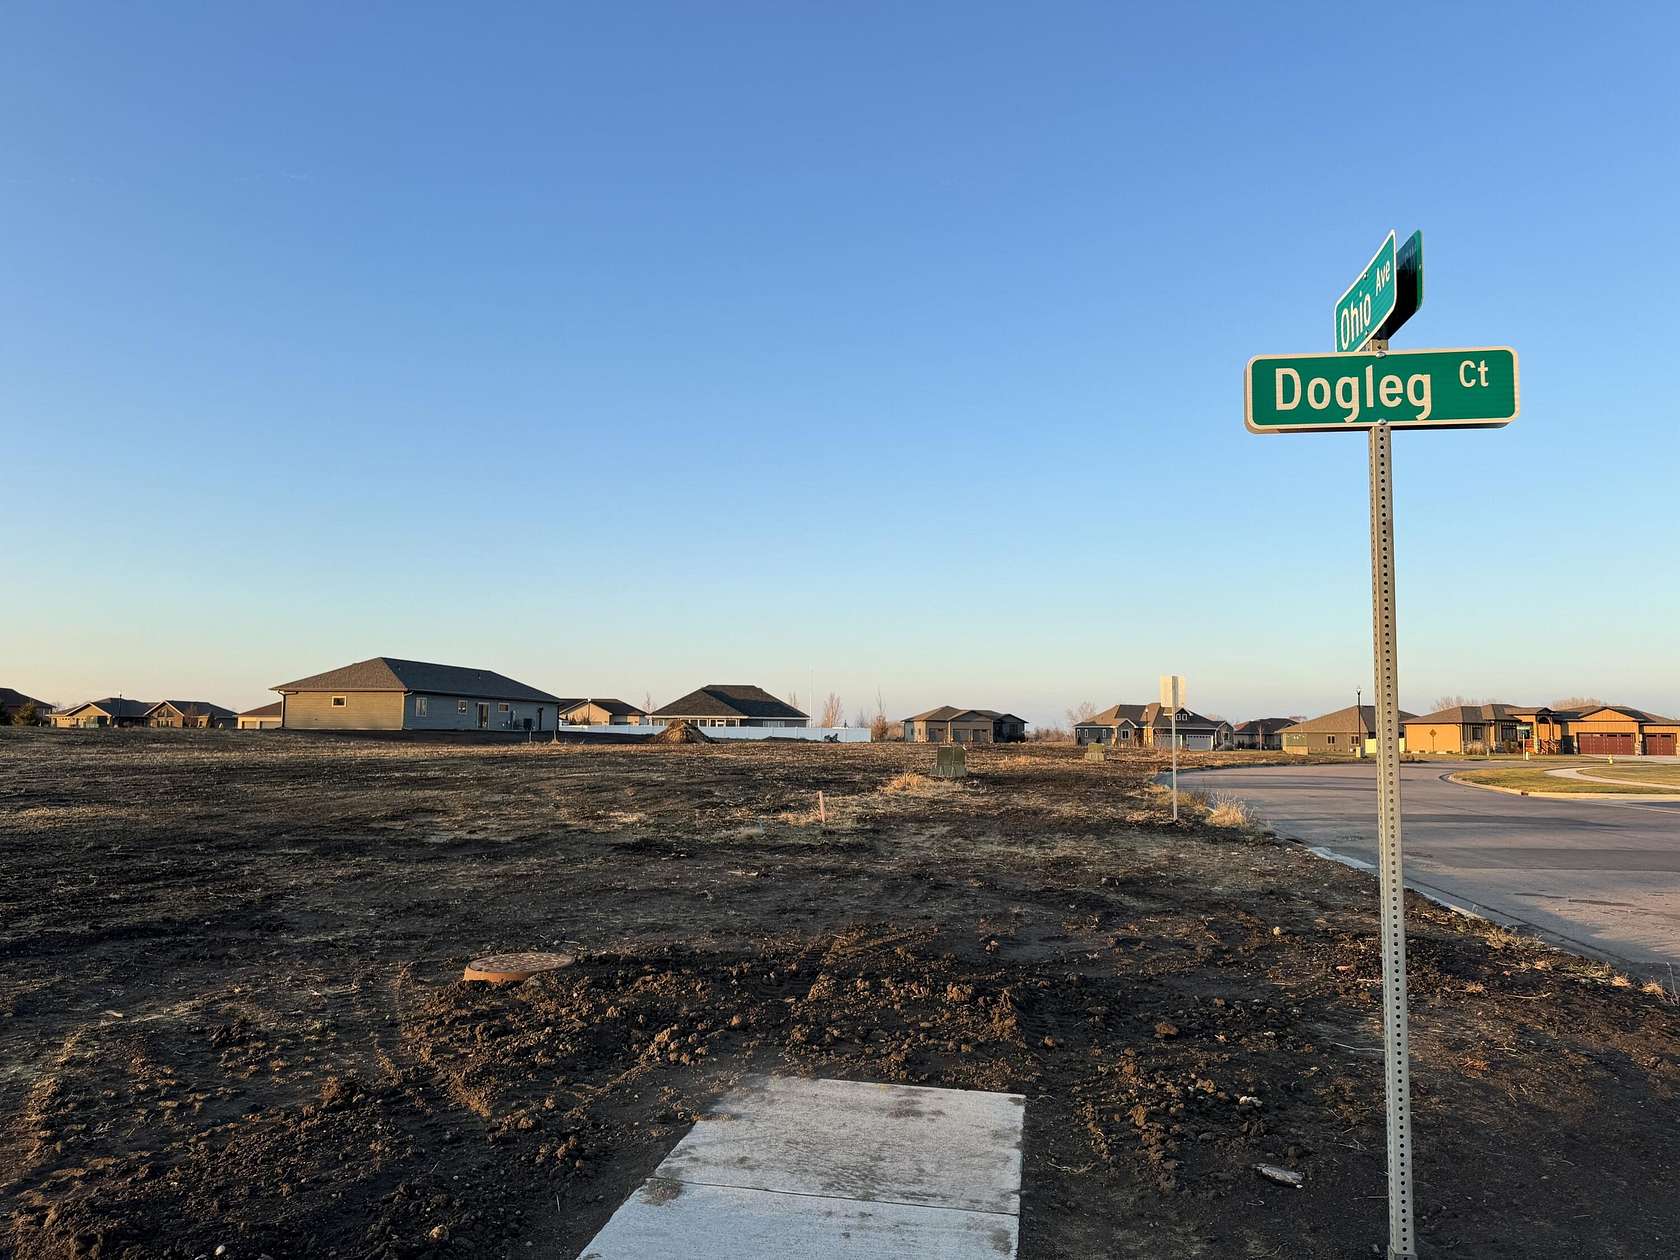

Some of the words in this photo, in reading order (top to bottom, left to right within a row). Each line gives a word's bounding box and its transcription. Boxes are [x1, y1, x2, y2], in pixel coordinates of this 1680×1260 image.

[1340, 291, 1371, 350] Ohio
[1375, 259, 1391, 297] Ave
[1275, 364, 1432, 423] Dogleg
[1458, 360, 1489, 388] Ct
